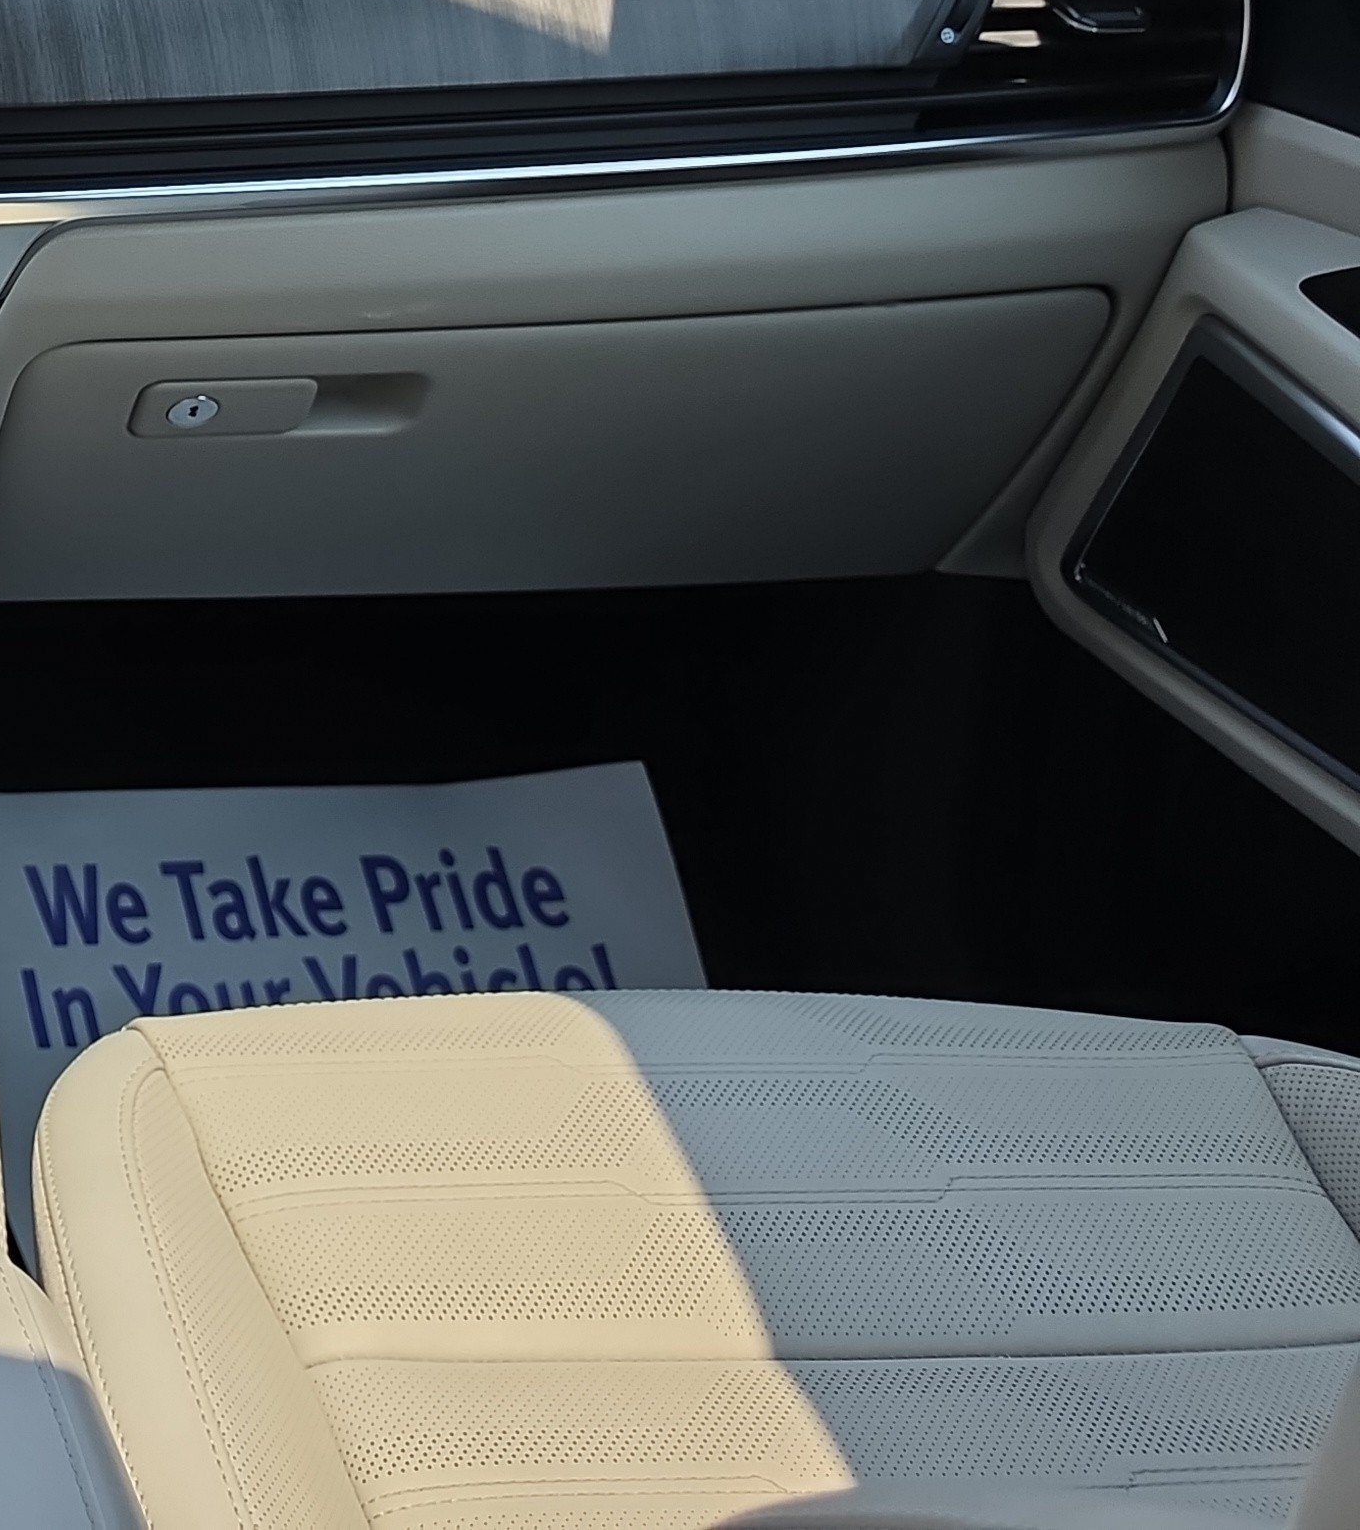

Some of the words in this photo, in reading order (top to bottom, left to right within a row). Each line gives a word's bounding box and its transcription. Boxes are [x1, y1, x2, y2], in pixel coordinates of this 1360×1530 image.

[23, 861, 153, 948] We
[159, 854, 350, 943] Take
[359, 843, 572, 935] Pride
[20, 966, 102, 1049] In
